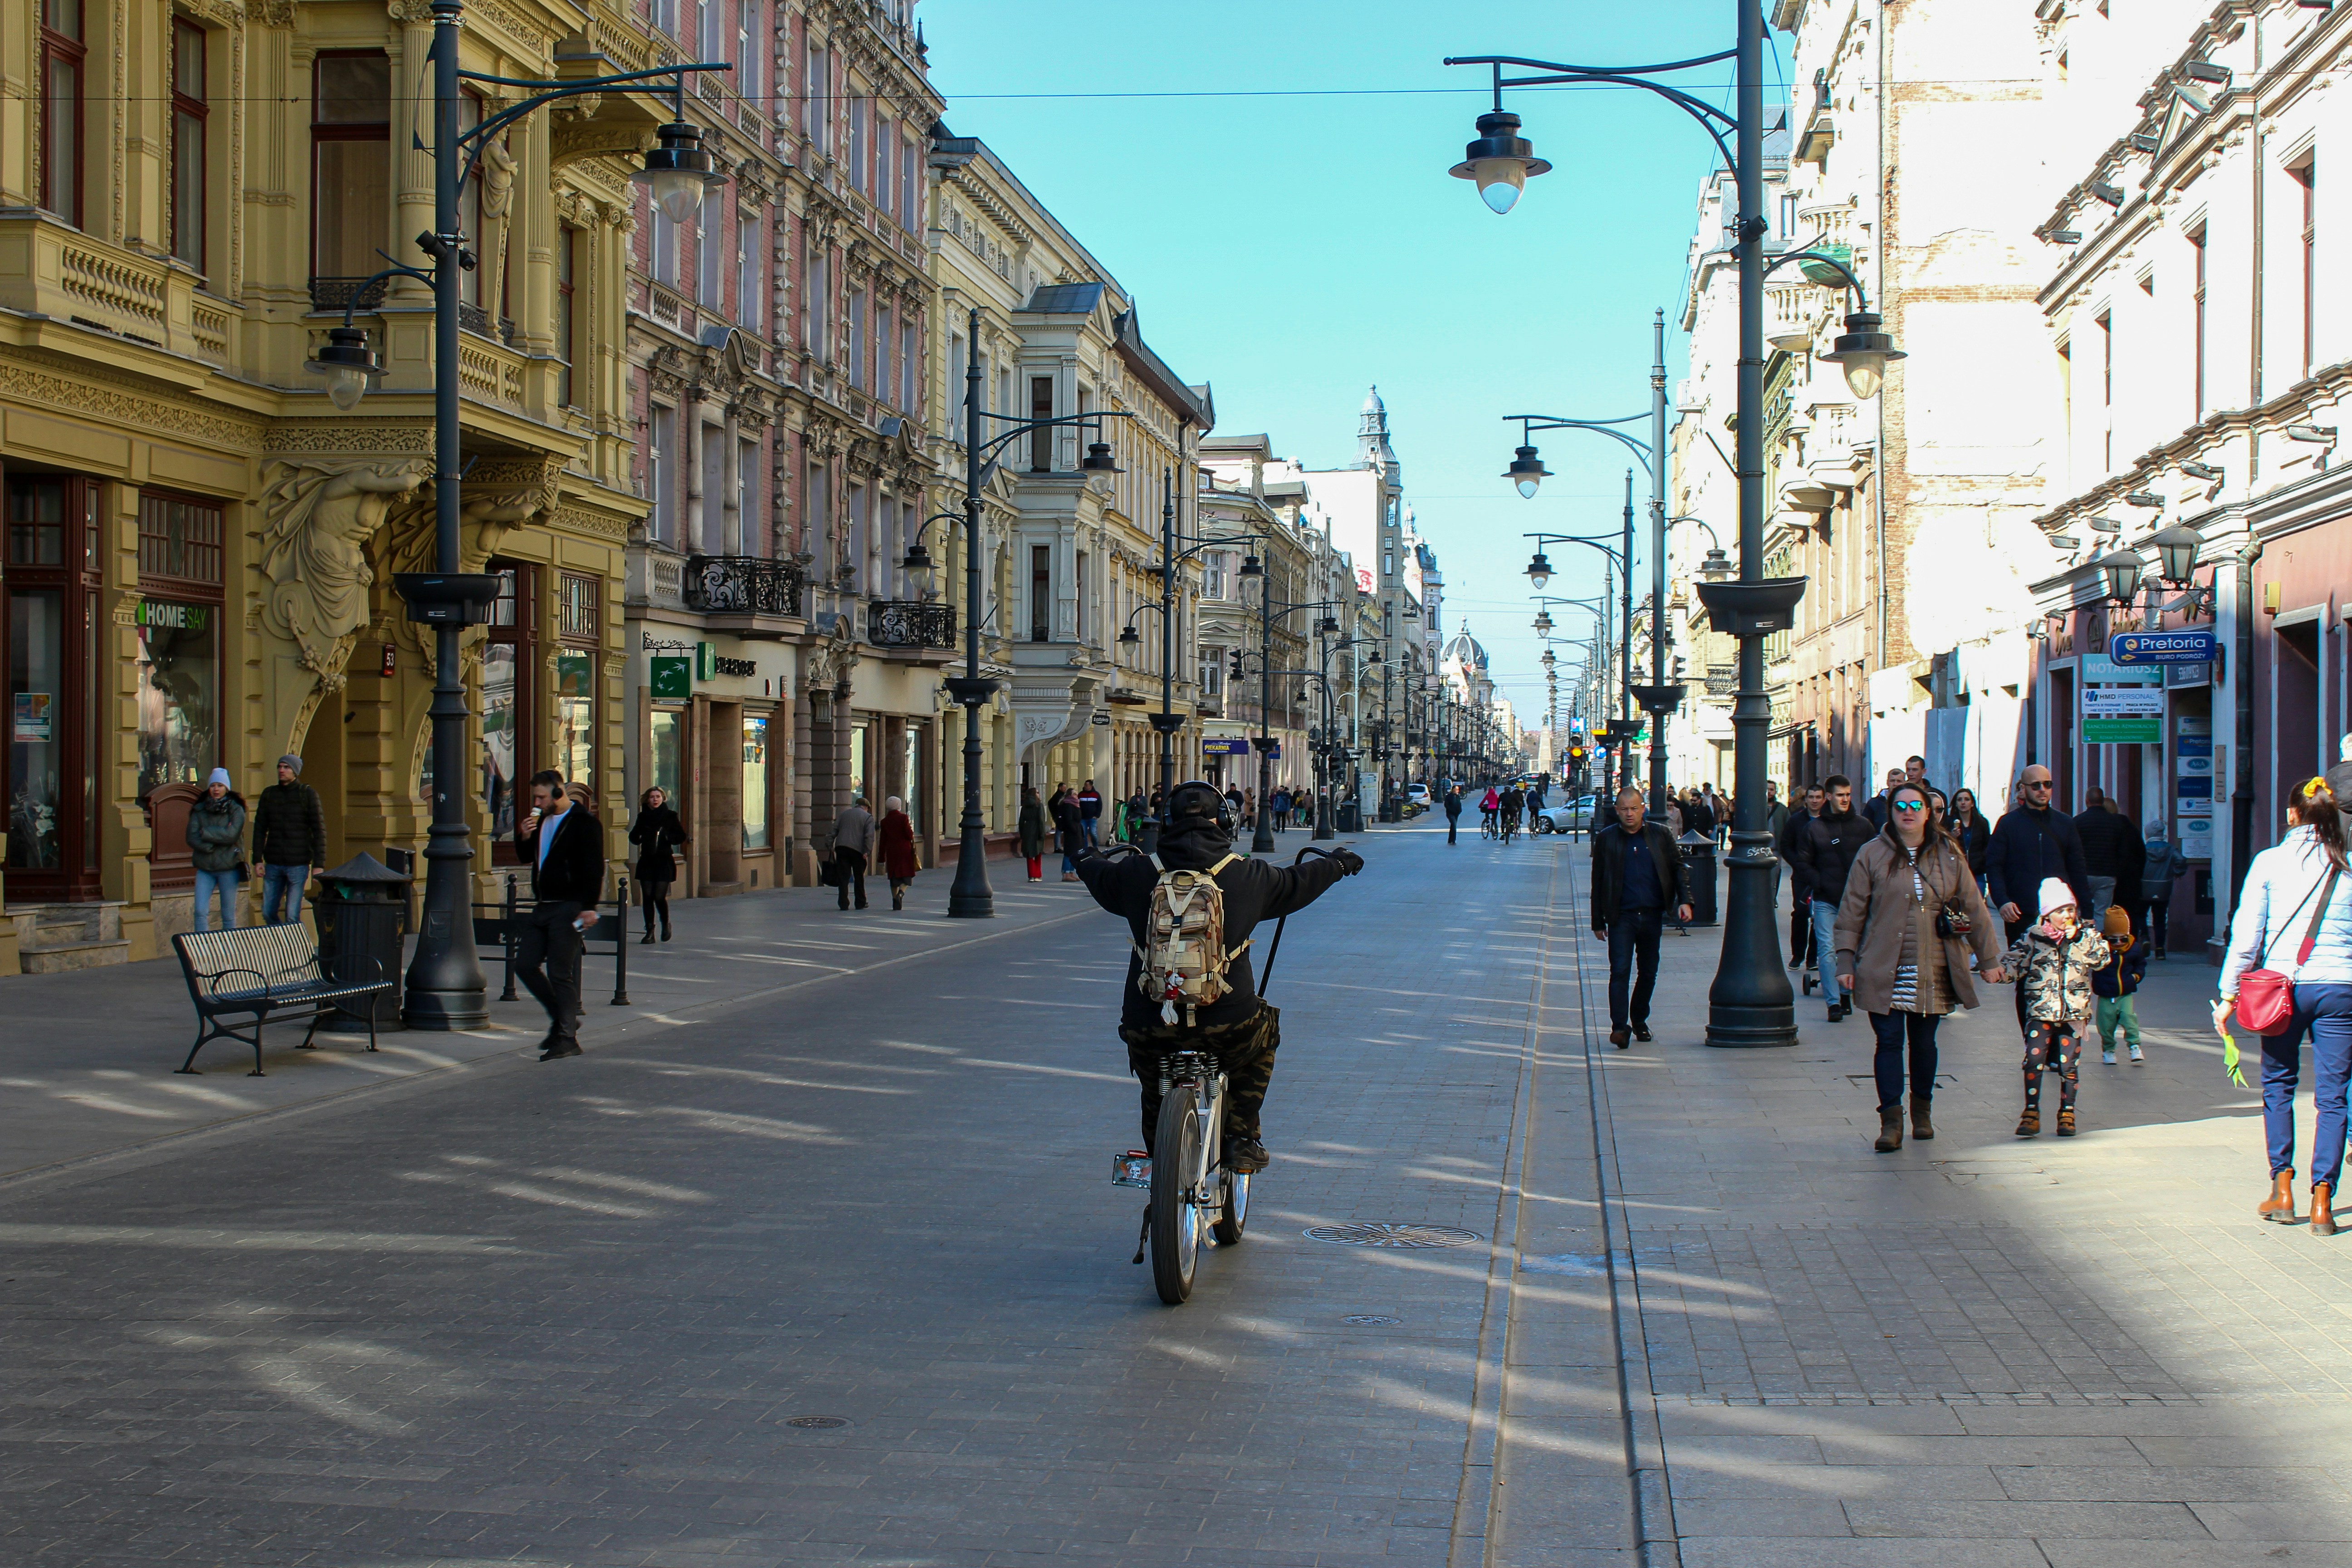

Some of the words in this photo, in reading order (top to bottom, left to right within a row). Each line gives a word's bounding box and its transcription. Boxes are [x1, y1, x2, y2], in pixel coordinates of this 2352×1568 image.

[2141, 637, 2206, 649] Pretoria
[387, 652, 394, 666] 53
[2087, 663, 2160, 673] NOTARIUSZ
